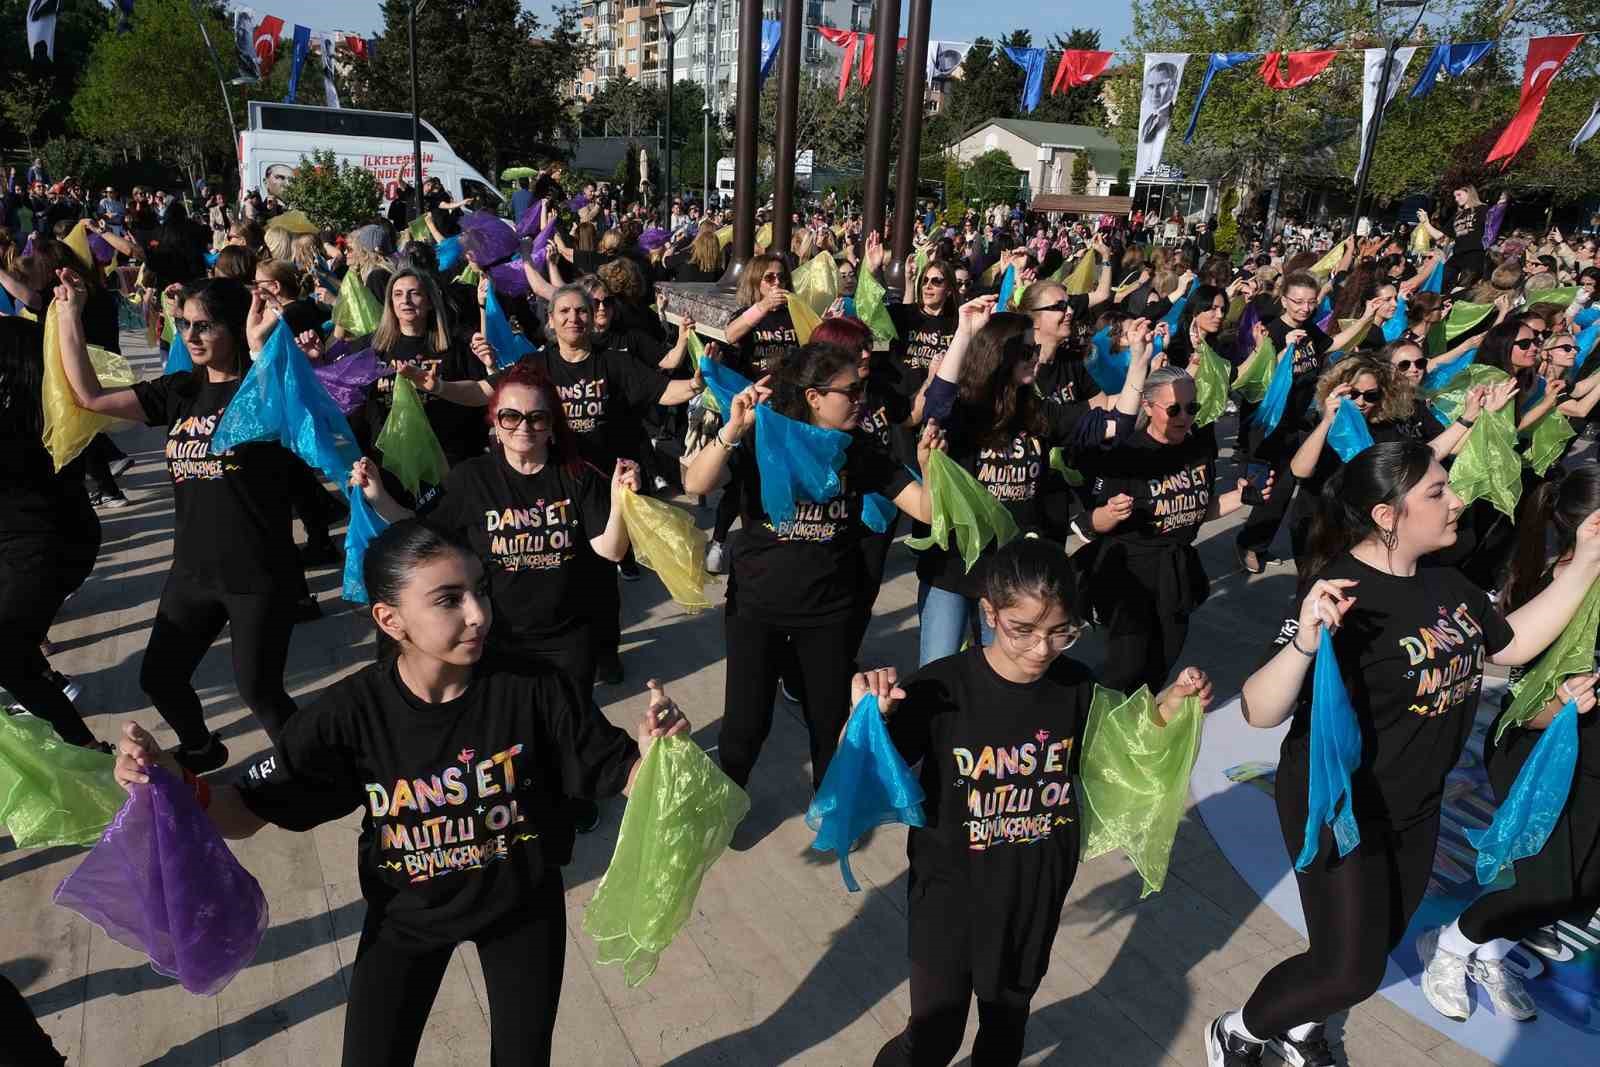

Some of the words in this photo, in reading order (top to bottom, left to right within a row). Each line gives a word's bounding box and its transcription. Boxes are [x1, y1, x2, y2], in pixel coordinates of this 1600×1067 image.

[585, 378, 605, 399] ET
[586, 401, 606, 416] OL
[165, 439, 209, 459] MUTLU
[978, 462, 1027, 482] MUTLU
[1150, 469, 1192, 498] DANS
[1191, 464, 1207, 488] ET
[485, 507, 543, 532] DANS
[545, 498, 571, 527] ET
[828, 500, 849, 519] OL
[1154, 493, 1197, 517] MUTLU
[491, 532, 544, 556] MUTLU
[550, 530, 573, 550] OL
[1399, 619, 1465, 666] DANS
[1452, 602, 1483, 638] ET
[1416, 654, 1473, 697] MUTLU
[952, 742, 1038, 781] DANS
[1043, 736, 1075, 776] ET
[365, 767, 468, 817] DANS
[476, 743, 524, 798] ET
[967, 783, 1034, 818] MUTLU
[1040, 782, 1071, 808] OL
[381, 815, 475, 851] MUTLU
[484, 800, 525, 831] OL
[968, 812, 1053, 848] BÜYÜKÇEKMECE
[403, 834, 509, 878] BÜYÜKÇEKMECE
